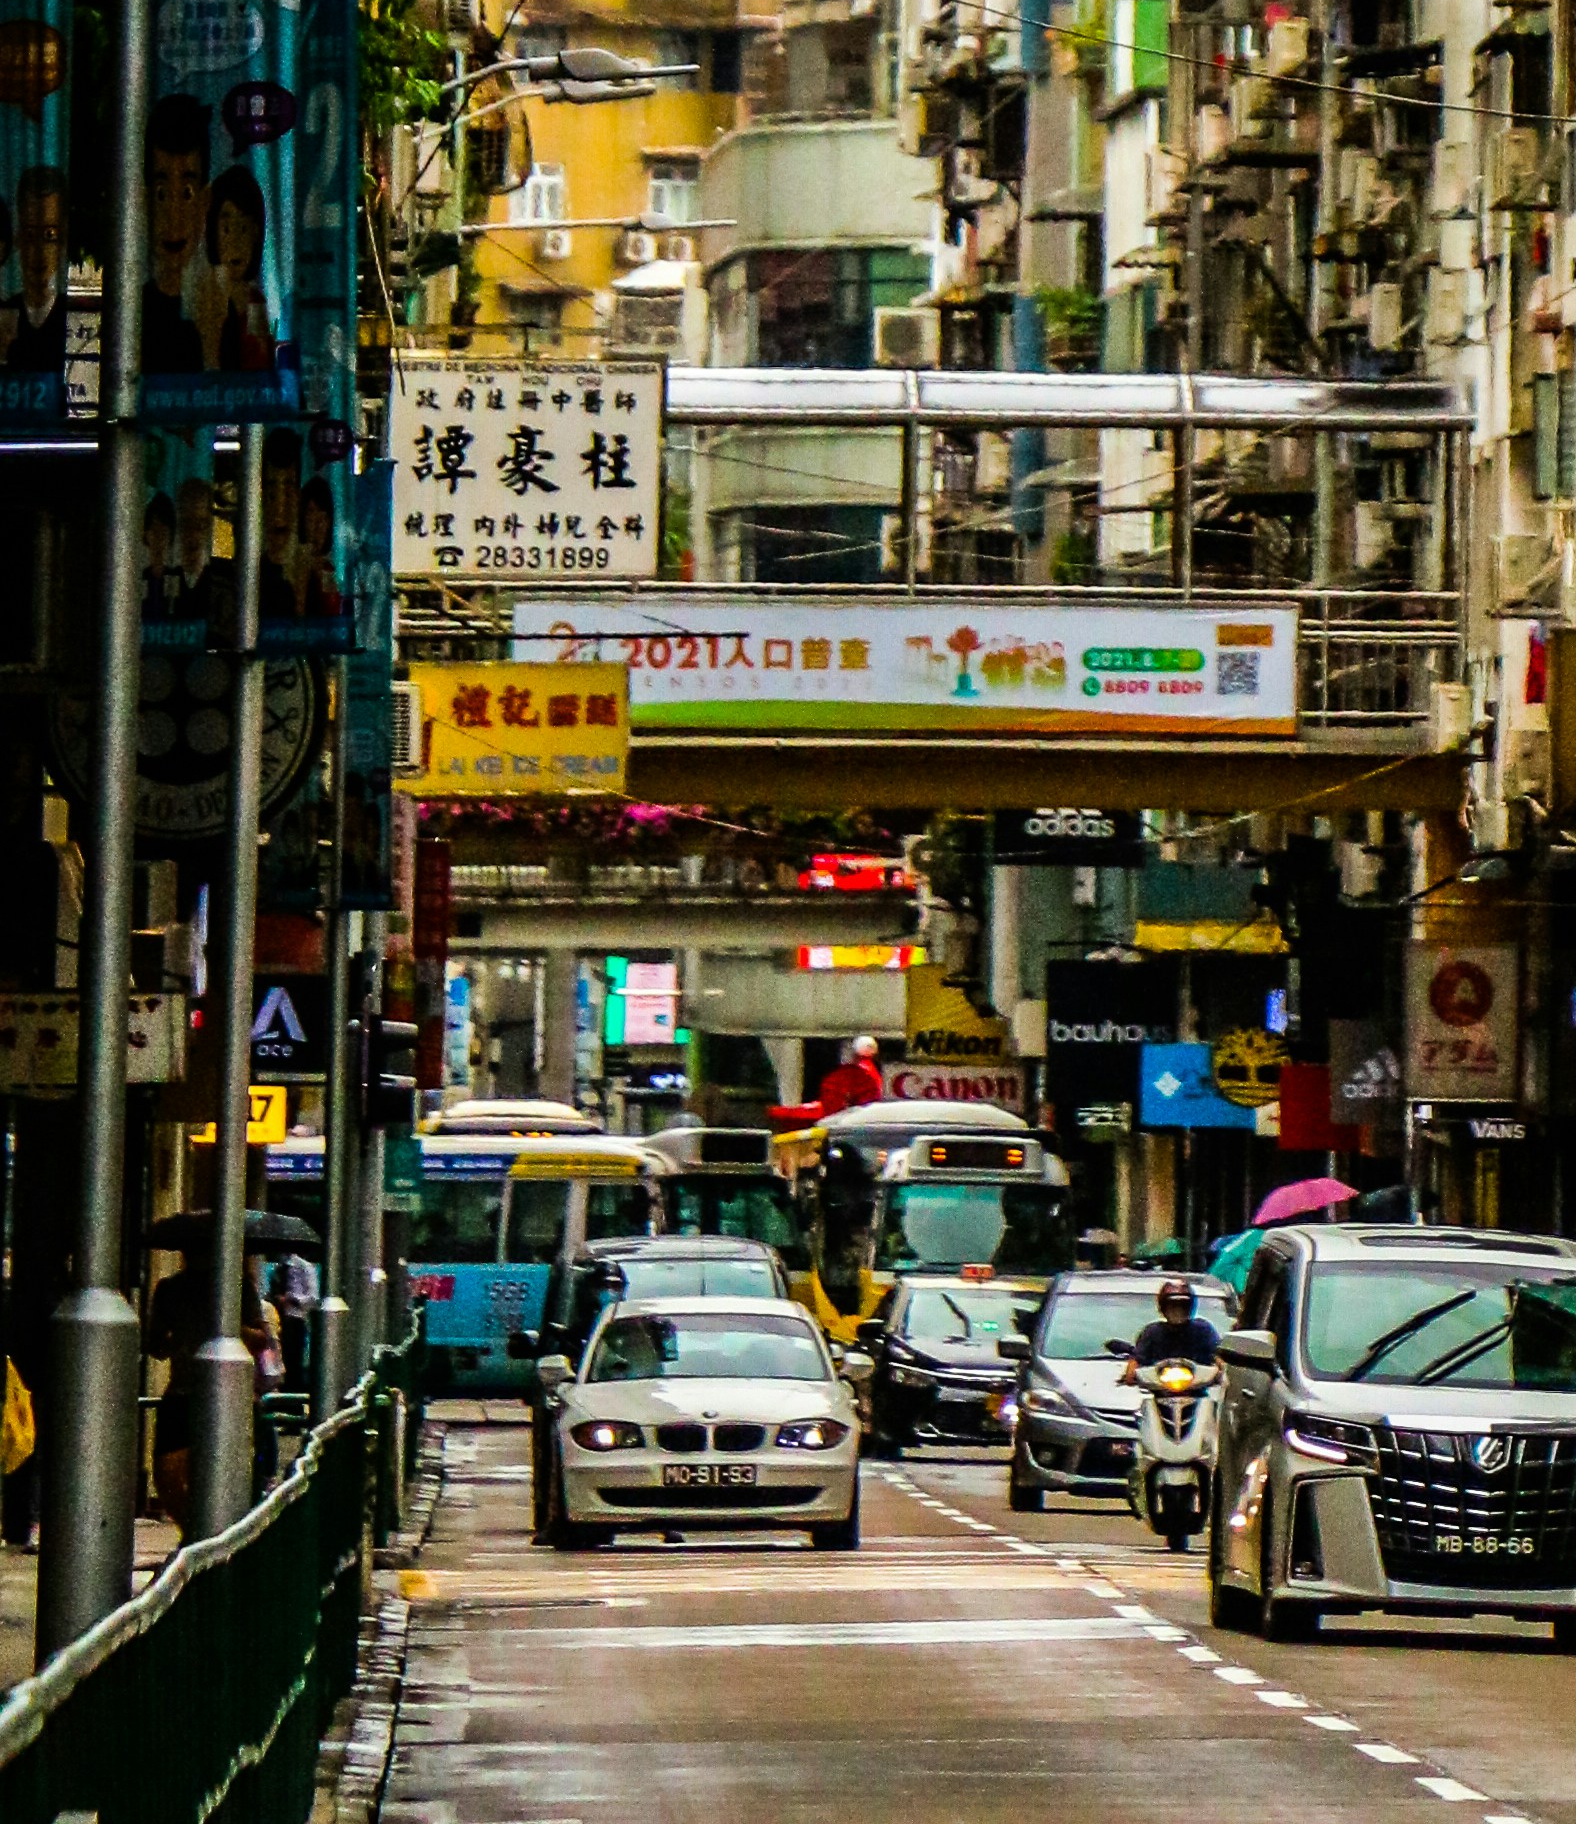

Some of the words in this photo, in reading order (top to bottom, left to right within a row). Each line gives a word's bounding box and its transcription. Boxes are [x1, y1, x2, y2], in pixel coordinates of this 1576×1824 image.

[411, 424, 638, 495] 譚豪柱
[475, 545, 610, 569] 28331899
[1023, 816, 1116, 838] adidas
[912, 1028, 1003, 1057] Nikon
[892, 1071, 1019, 1101] Canon
[1471, 1119, 1527, 1141] VANS
